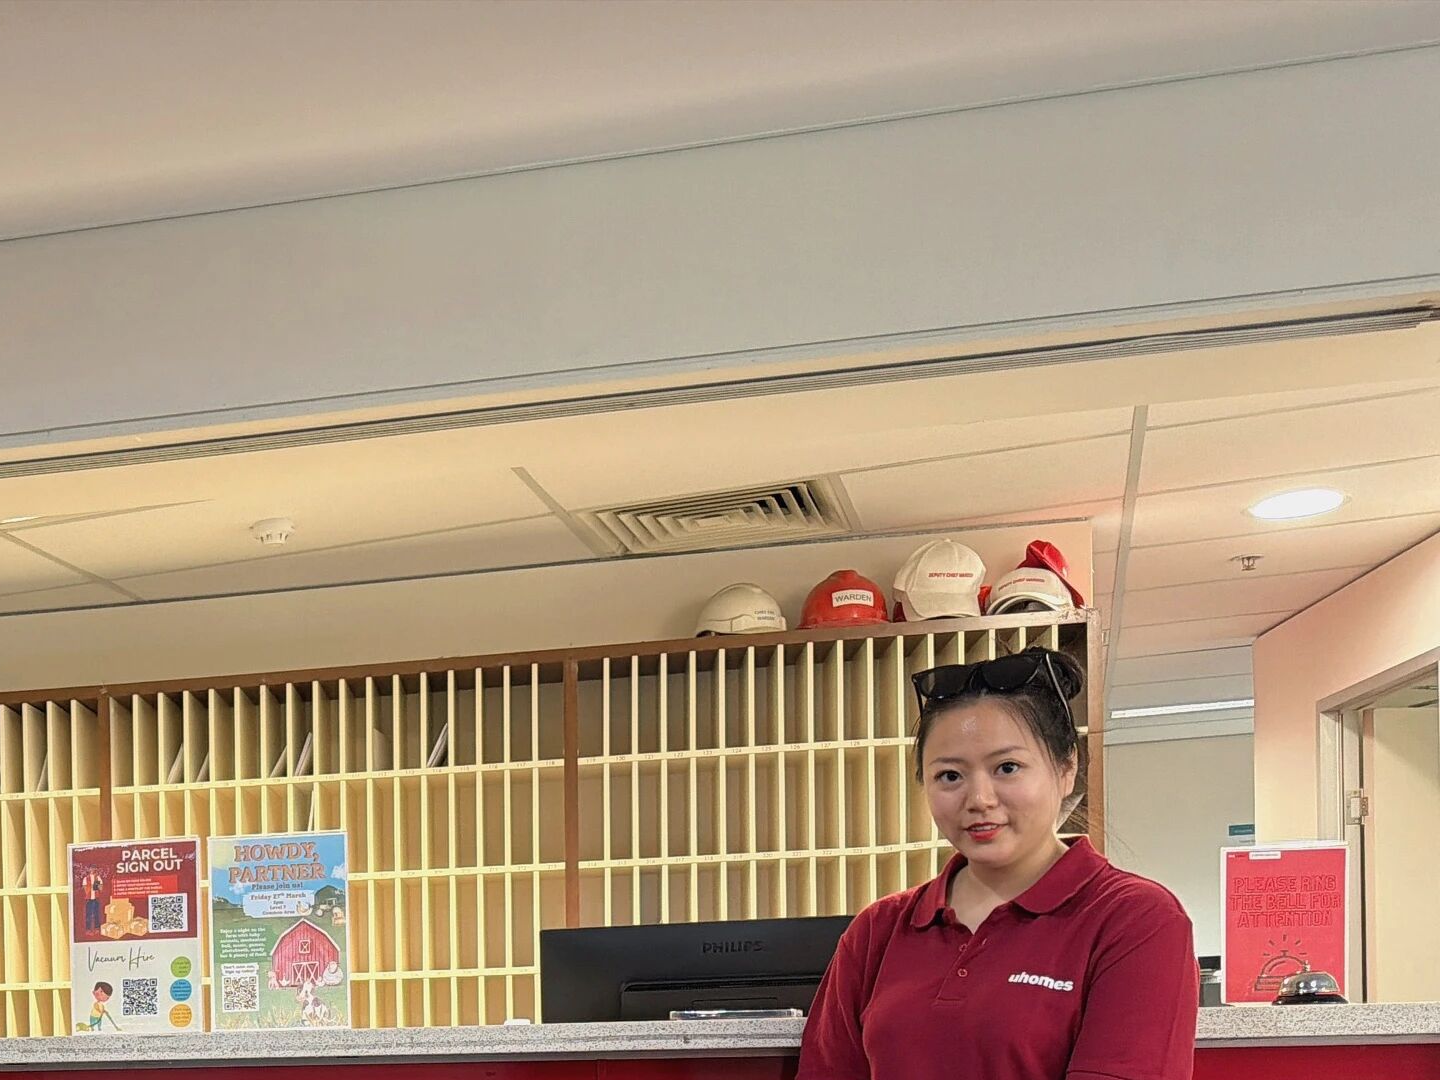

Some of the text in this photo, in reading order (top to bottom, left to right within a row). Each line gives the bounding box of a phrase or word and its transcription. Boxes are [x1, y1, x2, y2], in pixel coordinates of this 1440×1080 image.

[835, 593, 872, 602] WARDEN
[122, 848, 177, 861] PARCEL
[234, 842, 319, 862] HOWDY,
[116, 859, 183, 873] SIGN OUT
[229, 862, 326, 883] PARTNER
[276, 882, 290, 890] join
[1233, 875, 1337, 893] PLEASE RING
[1228, 892, 1341, 911] THE BELL FOR
[1237, 910, 1333, 928] ATTENTION
[703, 940, 763, 953] PHILIPS
[88, 946, 126, 972] Vacuum
[129, 946, 155, 971] Hire
[1008, 971, 1074, 992] uhomes
